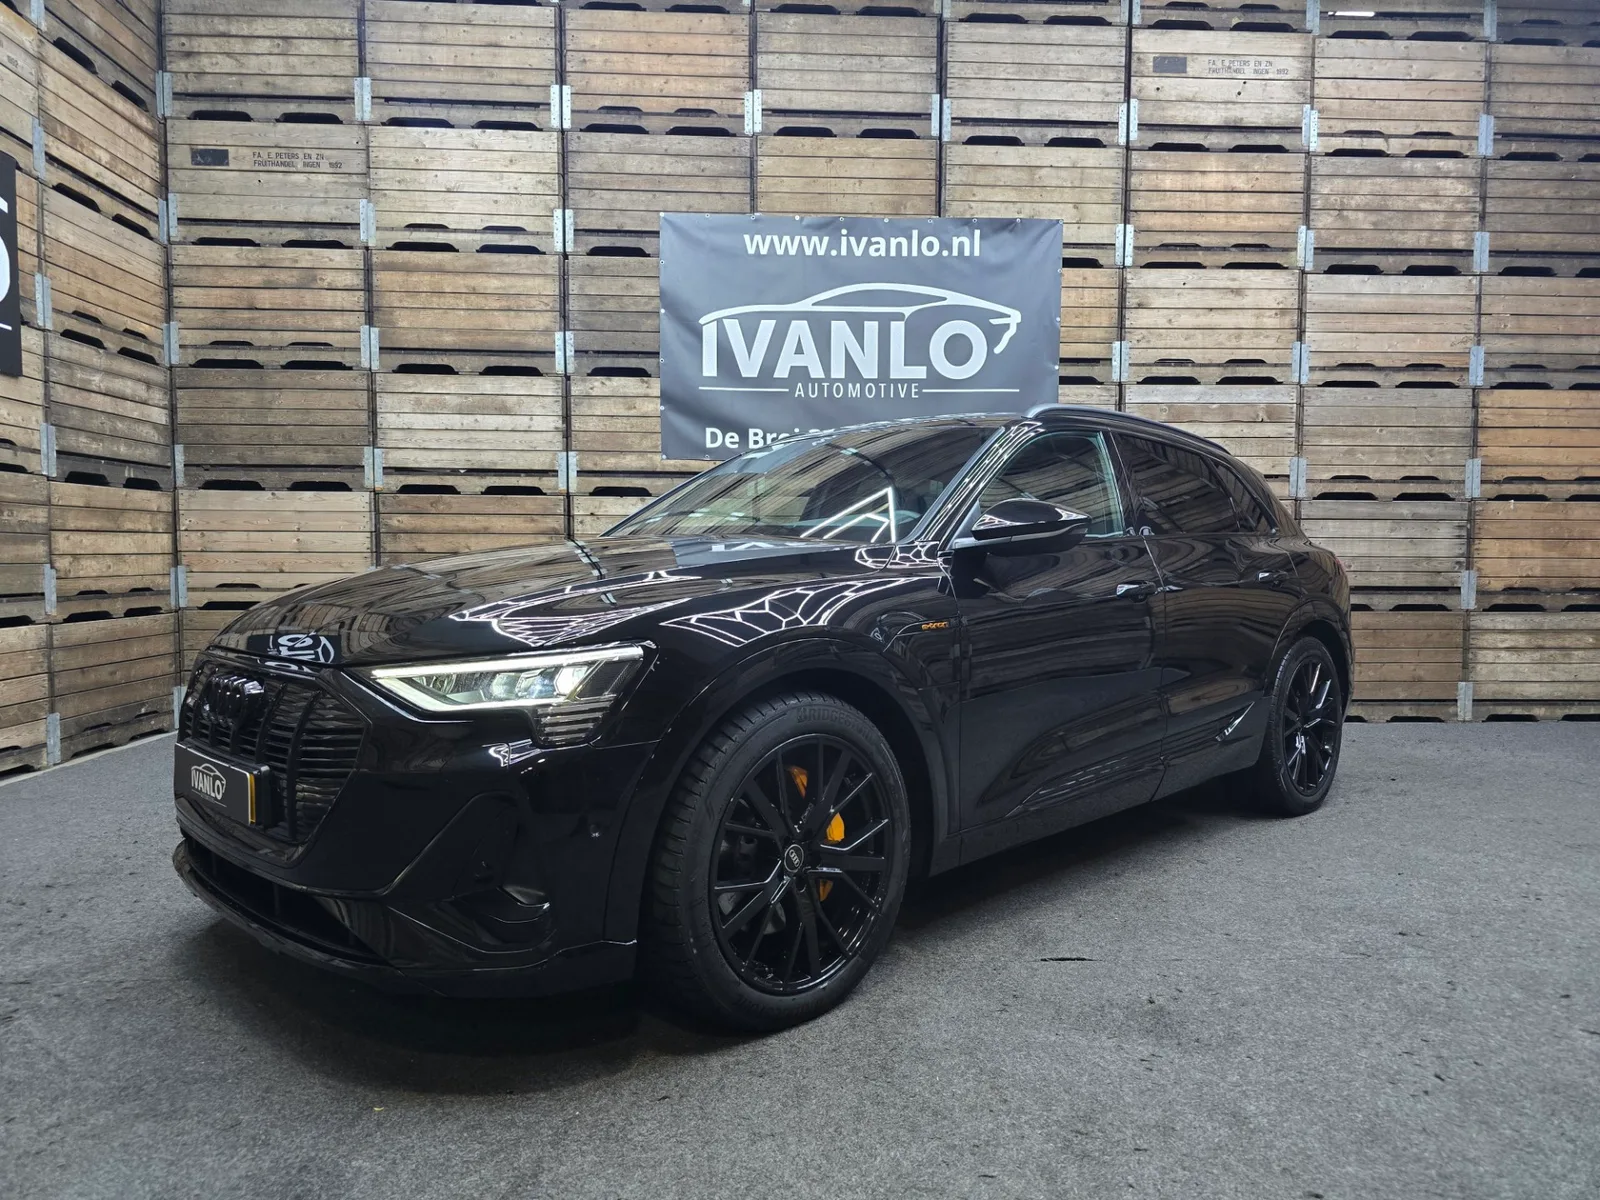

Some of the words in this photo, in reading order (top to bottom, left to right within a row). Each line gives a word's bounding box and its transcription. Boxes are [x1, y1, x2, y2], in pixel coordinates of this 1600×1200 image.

[253, 159, 296, 168] FRUITHANDEL
[275, 152, 300, 160] PETERS
[743, 229, 981, 257] www.ivanlo.nl
[701, 319, 988, 380] IVANLO
[794, 382, 919, 398] AUTOMOTIVE
[705, 427, 740, 449] De
[191, 769, 223, 800] IVANLO
